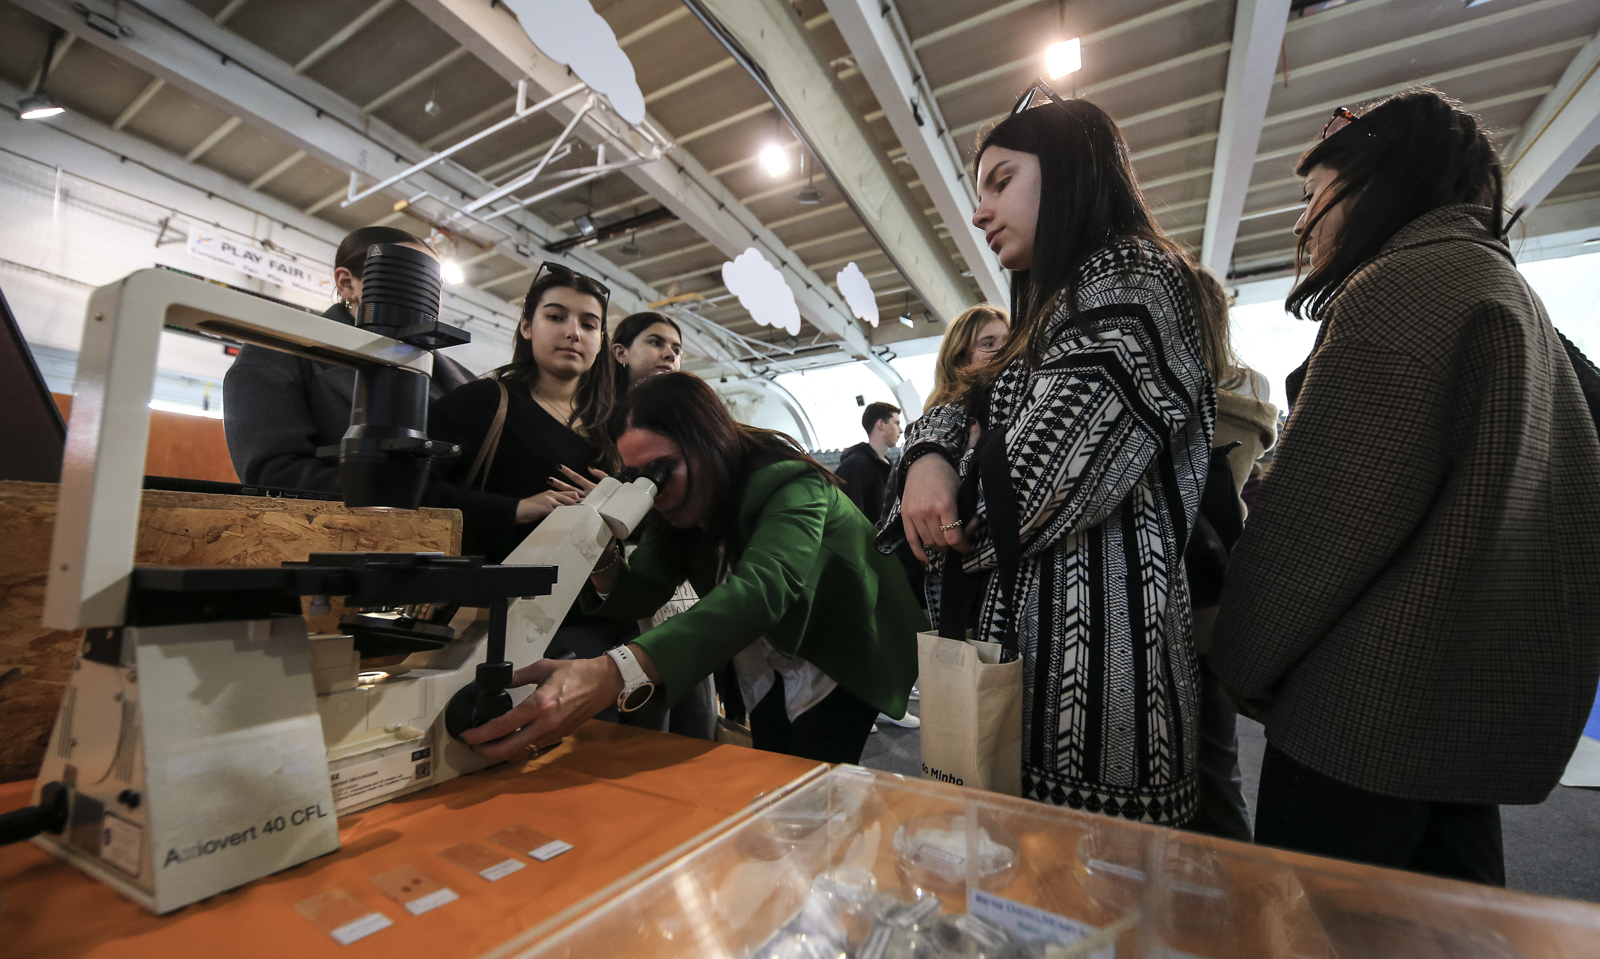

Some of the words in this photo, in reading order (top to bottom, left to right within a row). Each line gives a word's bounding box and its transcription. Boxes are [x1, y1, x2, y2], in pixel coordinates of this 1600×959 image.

[221, 242, 262, 262] PLAY
[931, 767, 963, 786] Minho
[262, 816, 286, 834] 40
[291, 804, 328, 826] CFL
